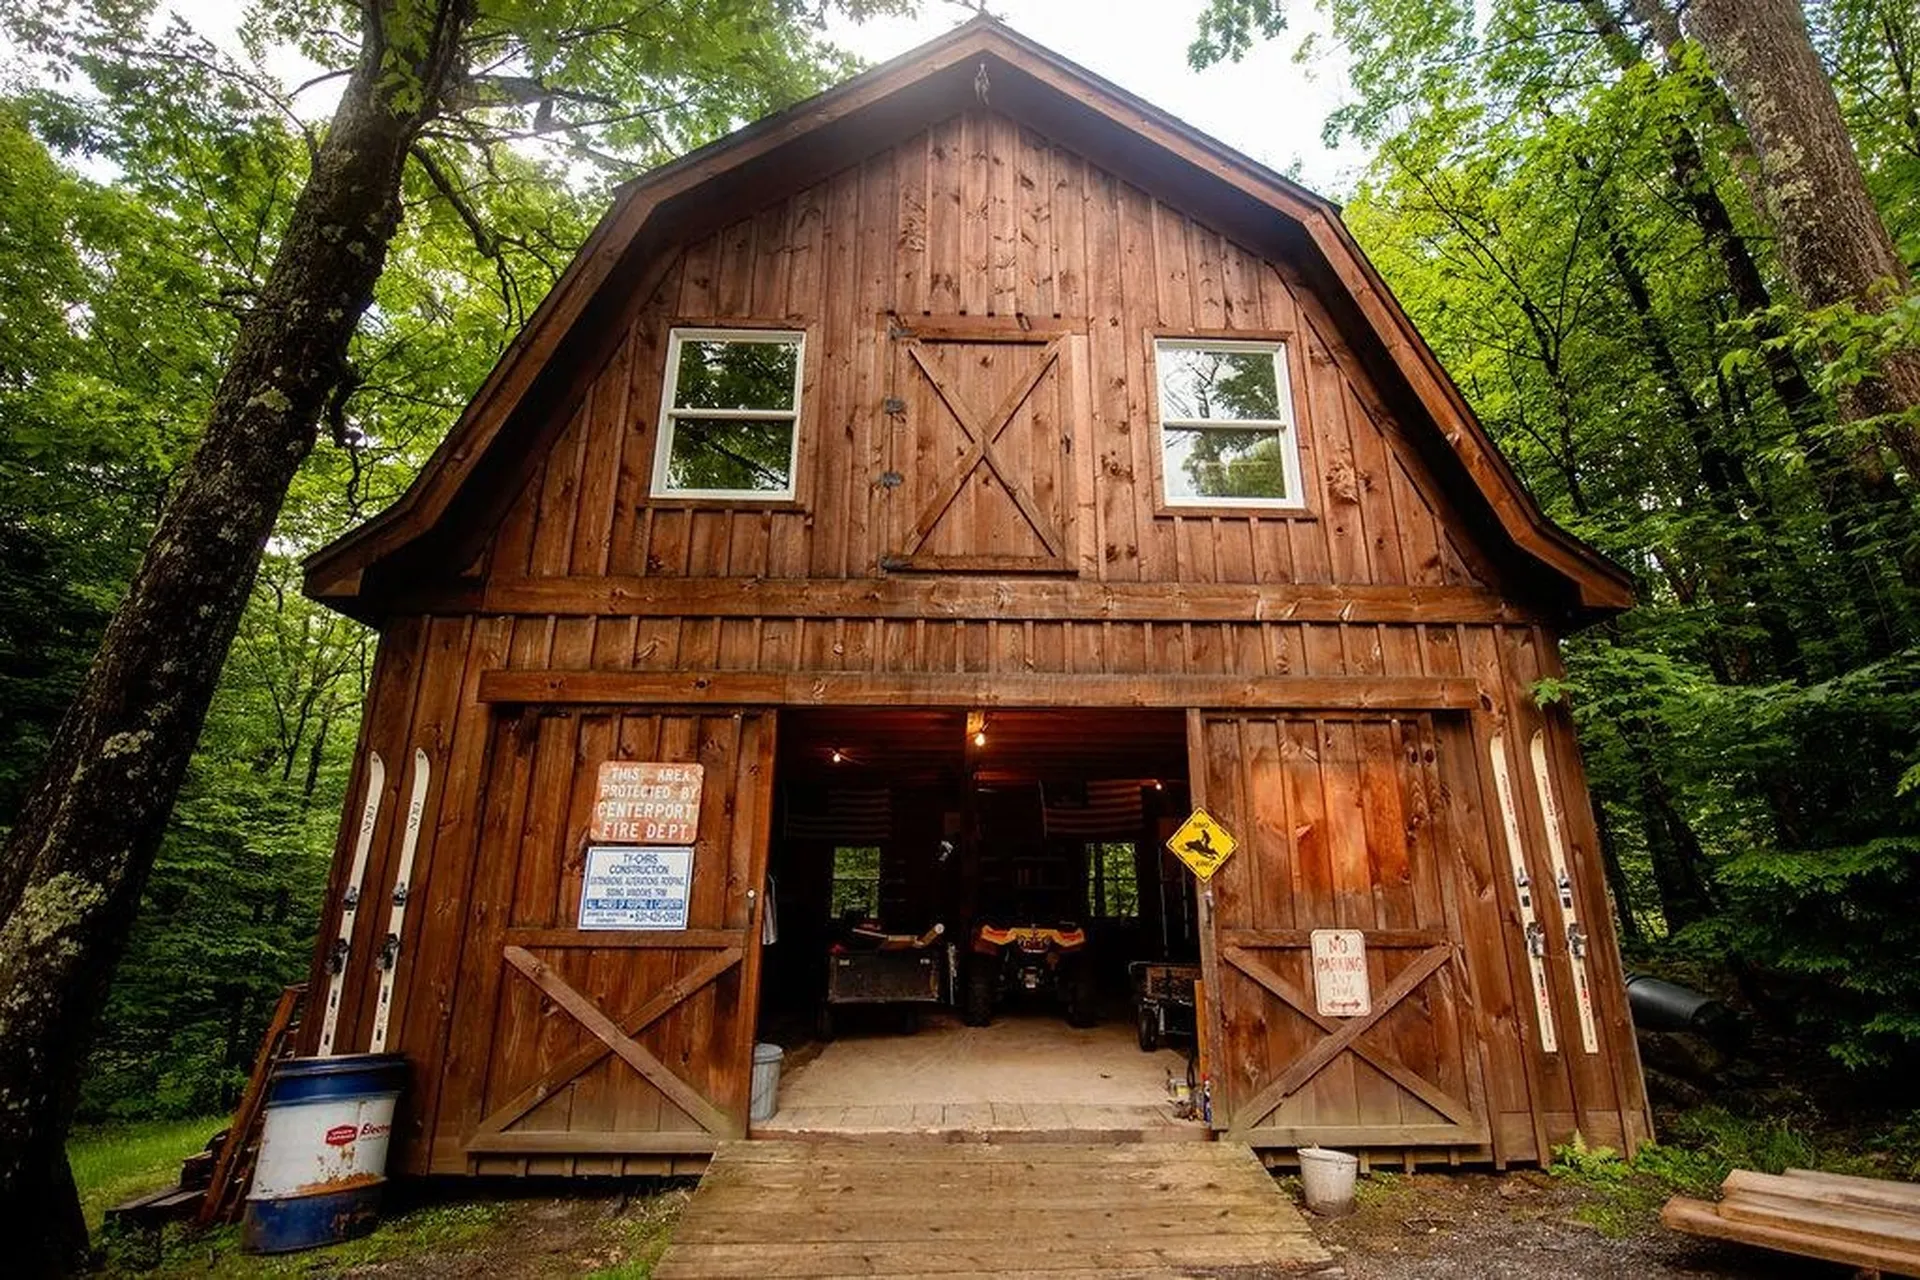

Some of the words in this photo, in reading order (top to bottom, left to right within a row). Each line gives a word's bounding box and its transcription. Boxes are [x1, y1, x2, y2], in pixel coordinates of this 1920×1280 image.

[611, 767, 640, 780] THIS
[657, 768, 691, 781] AREA
[601, 784, 671, 799] PROTECTED
[680, 786, 698, 800] BY
[597, 801, 694, 819] CENTERPORT
[603, 822, 640, 838] FIRE
[609, 864, 670, 874] CONSTRUCTION
[1329, 939, 1348, 954] NO
[1318, 957, 1361, 972] PARKING
